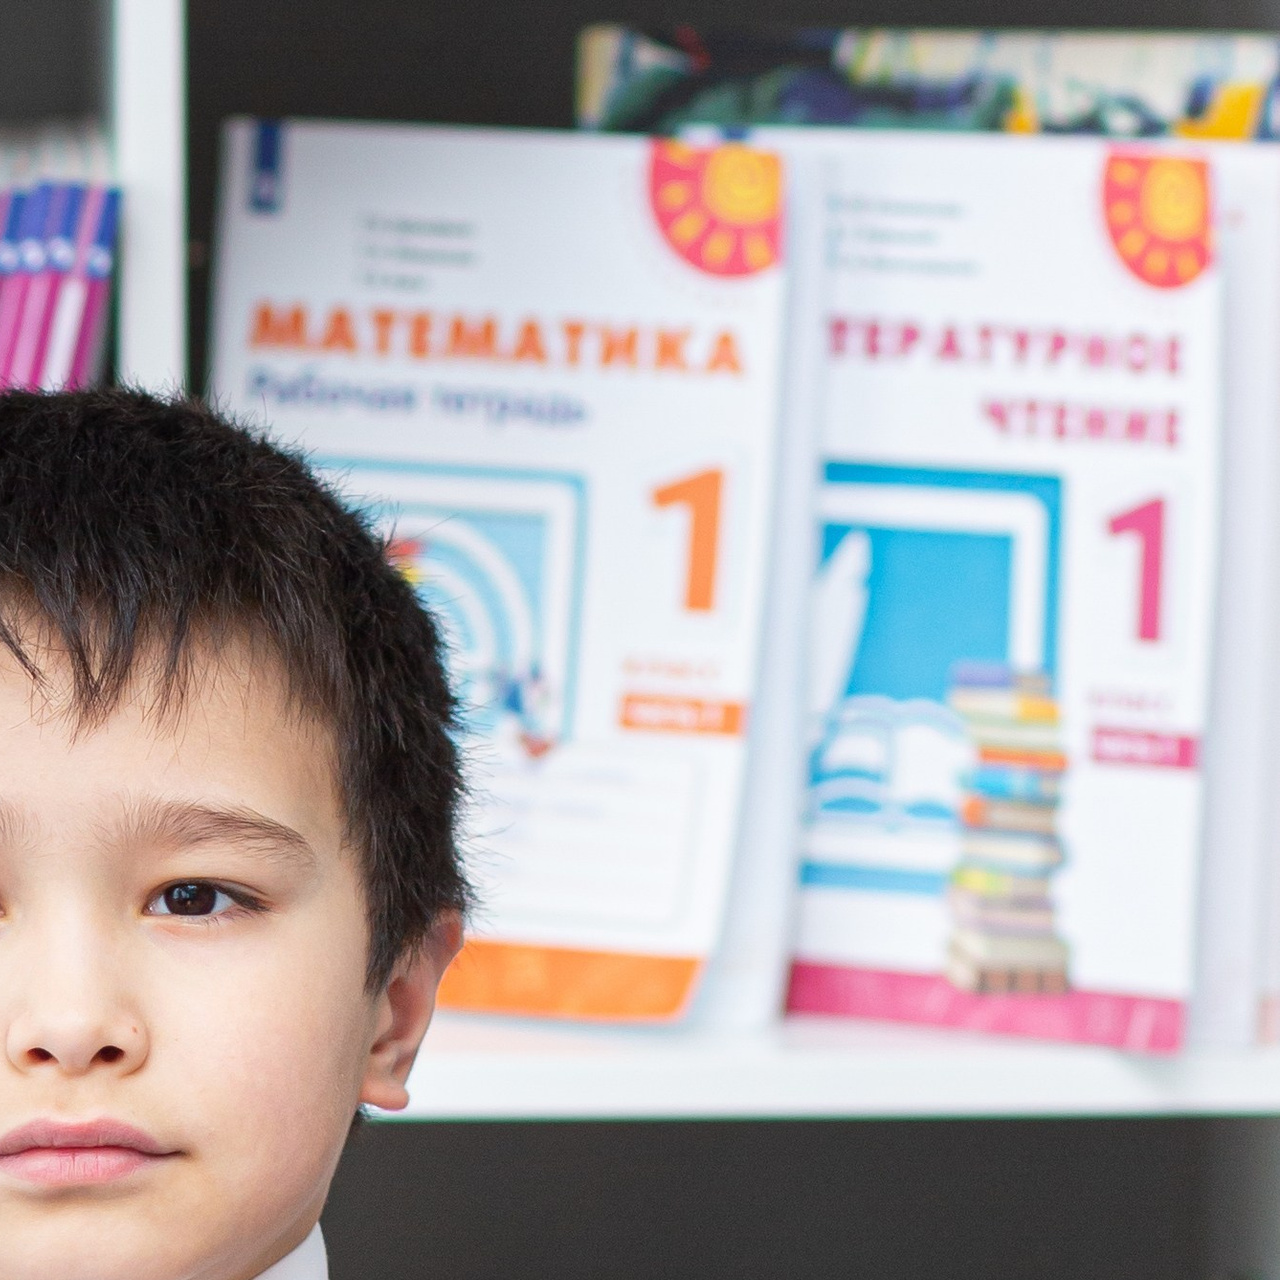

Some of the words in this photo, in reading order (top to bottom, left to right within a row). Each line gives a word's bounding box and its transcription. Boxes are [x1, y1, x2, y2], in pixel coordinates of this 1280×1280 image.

[249, 301, 743, 376] МАТЕМАТИКА
[985, 399, 1183, 449] ЧТЕНИЕ
[653, 468, 724, 613] 1
[1108, 498, 1166, 644] 1
